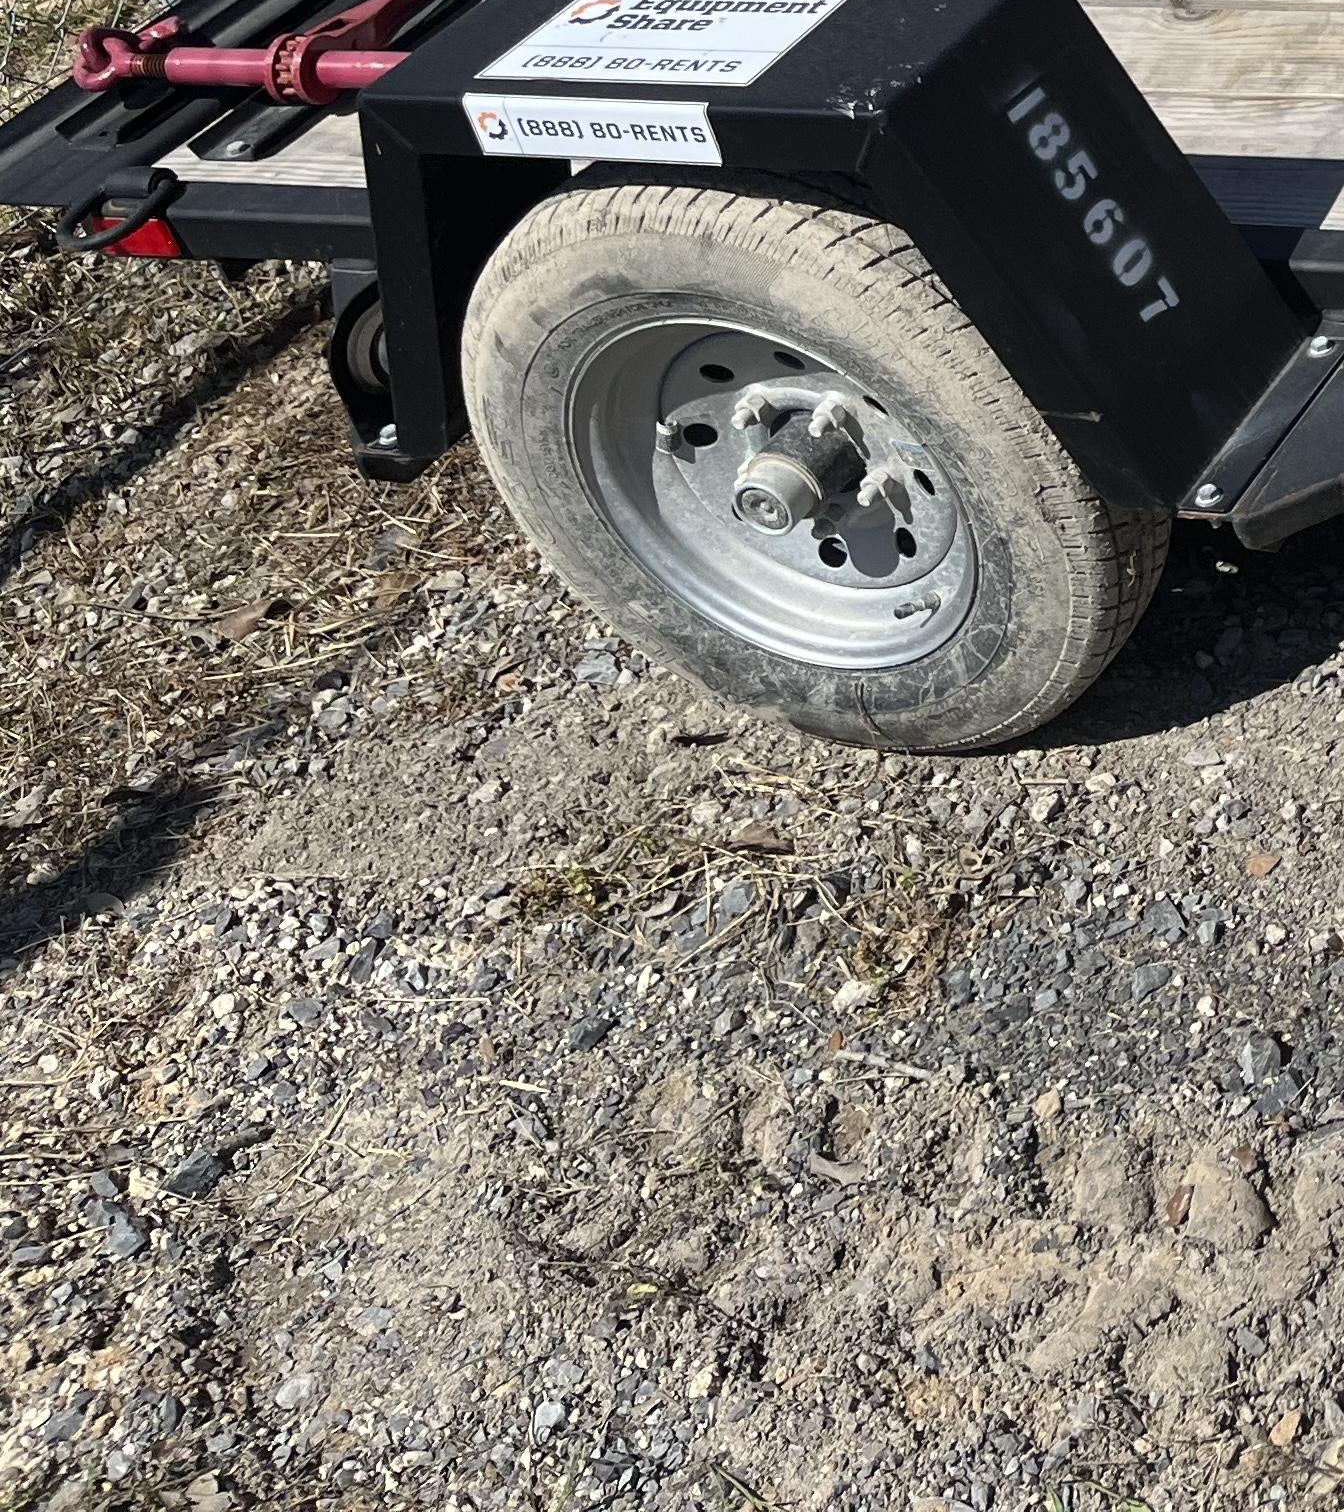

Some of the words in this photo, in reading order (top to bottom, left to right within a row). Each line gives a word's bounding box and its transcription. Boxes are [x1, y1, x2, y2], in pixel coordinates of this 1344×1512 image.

[605, 13, 714, 32] Share
[521, 54, 604, 70] (888)
[603, 55, 743, 73] 80-RENTS
[516, 117, 585, 140] (888)
[590, 121, 708, 144] 80-RENTS
[1006, 86, 1180, 323] 185607
